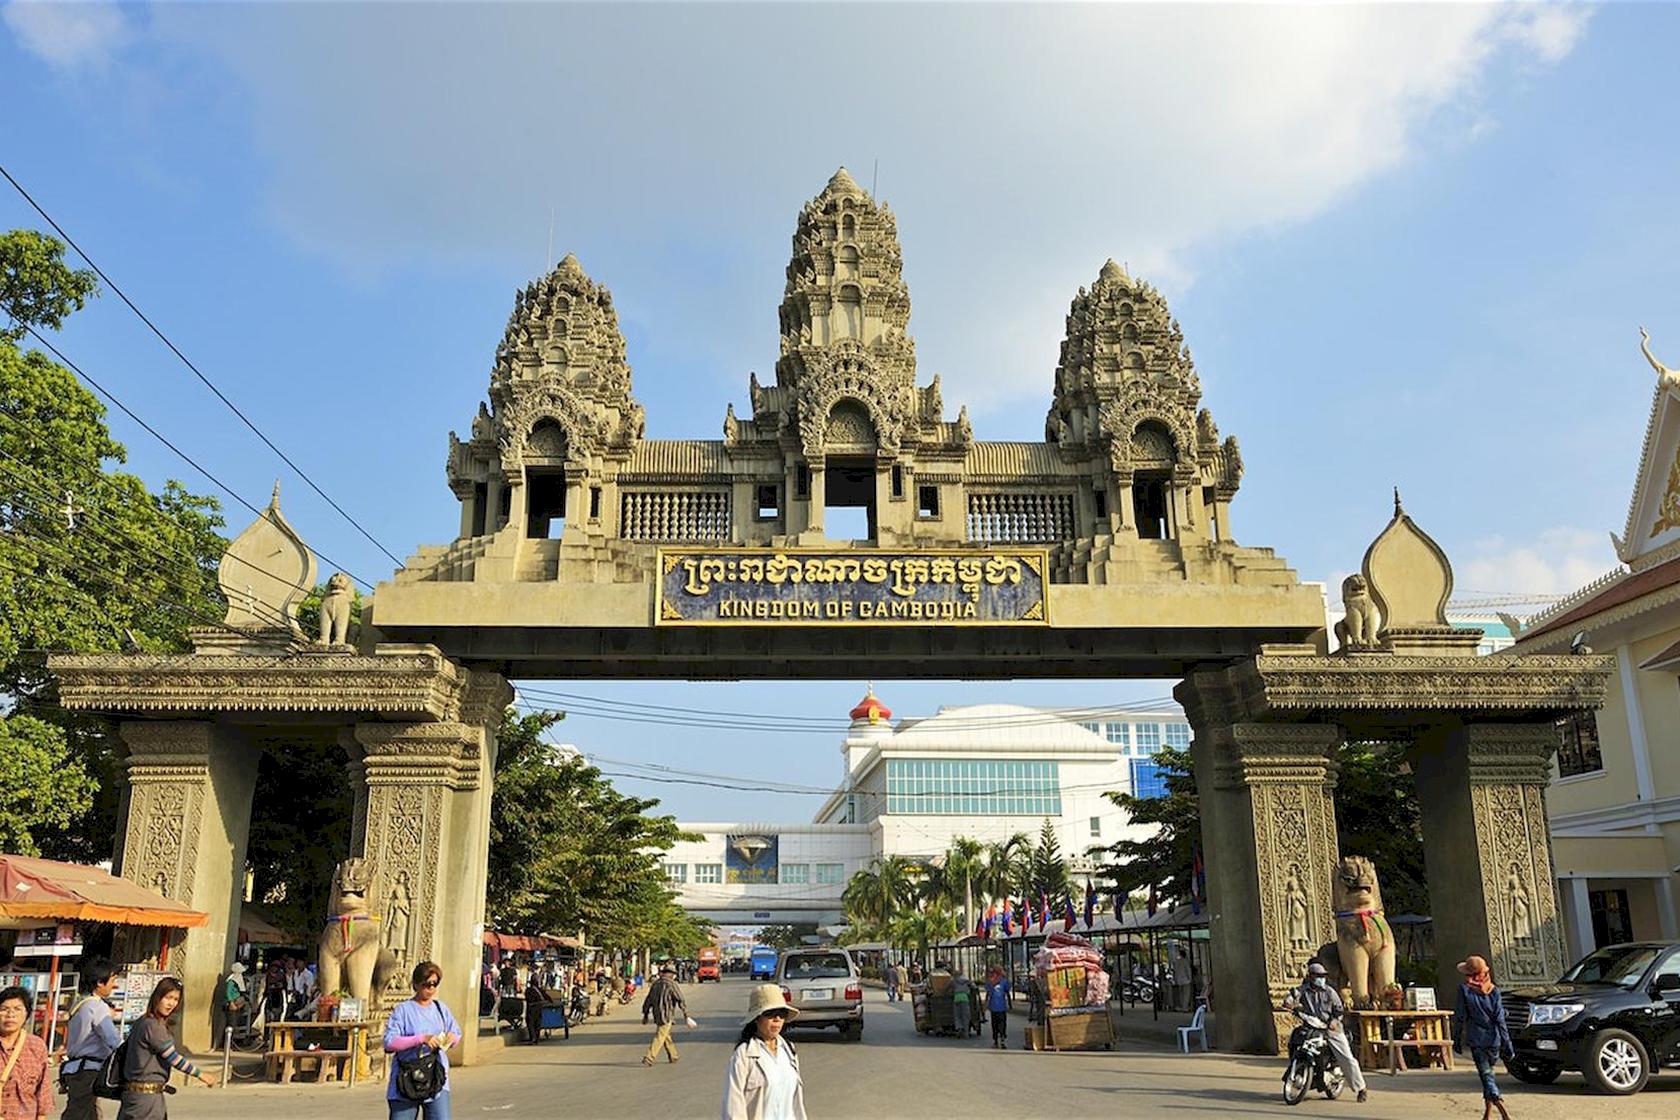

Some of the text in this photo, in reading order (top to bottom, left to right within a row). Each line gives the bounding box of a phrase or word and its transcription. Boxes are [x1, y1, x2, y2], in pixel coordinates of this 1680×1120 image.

[719, 600, 977, 618] KINGDOM OF CAMBODIA
